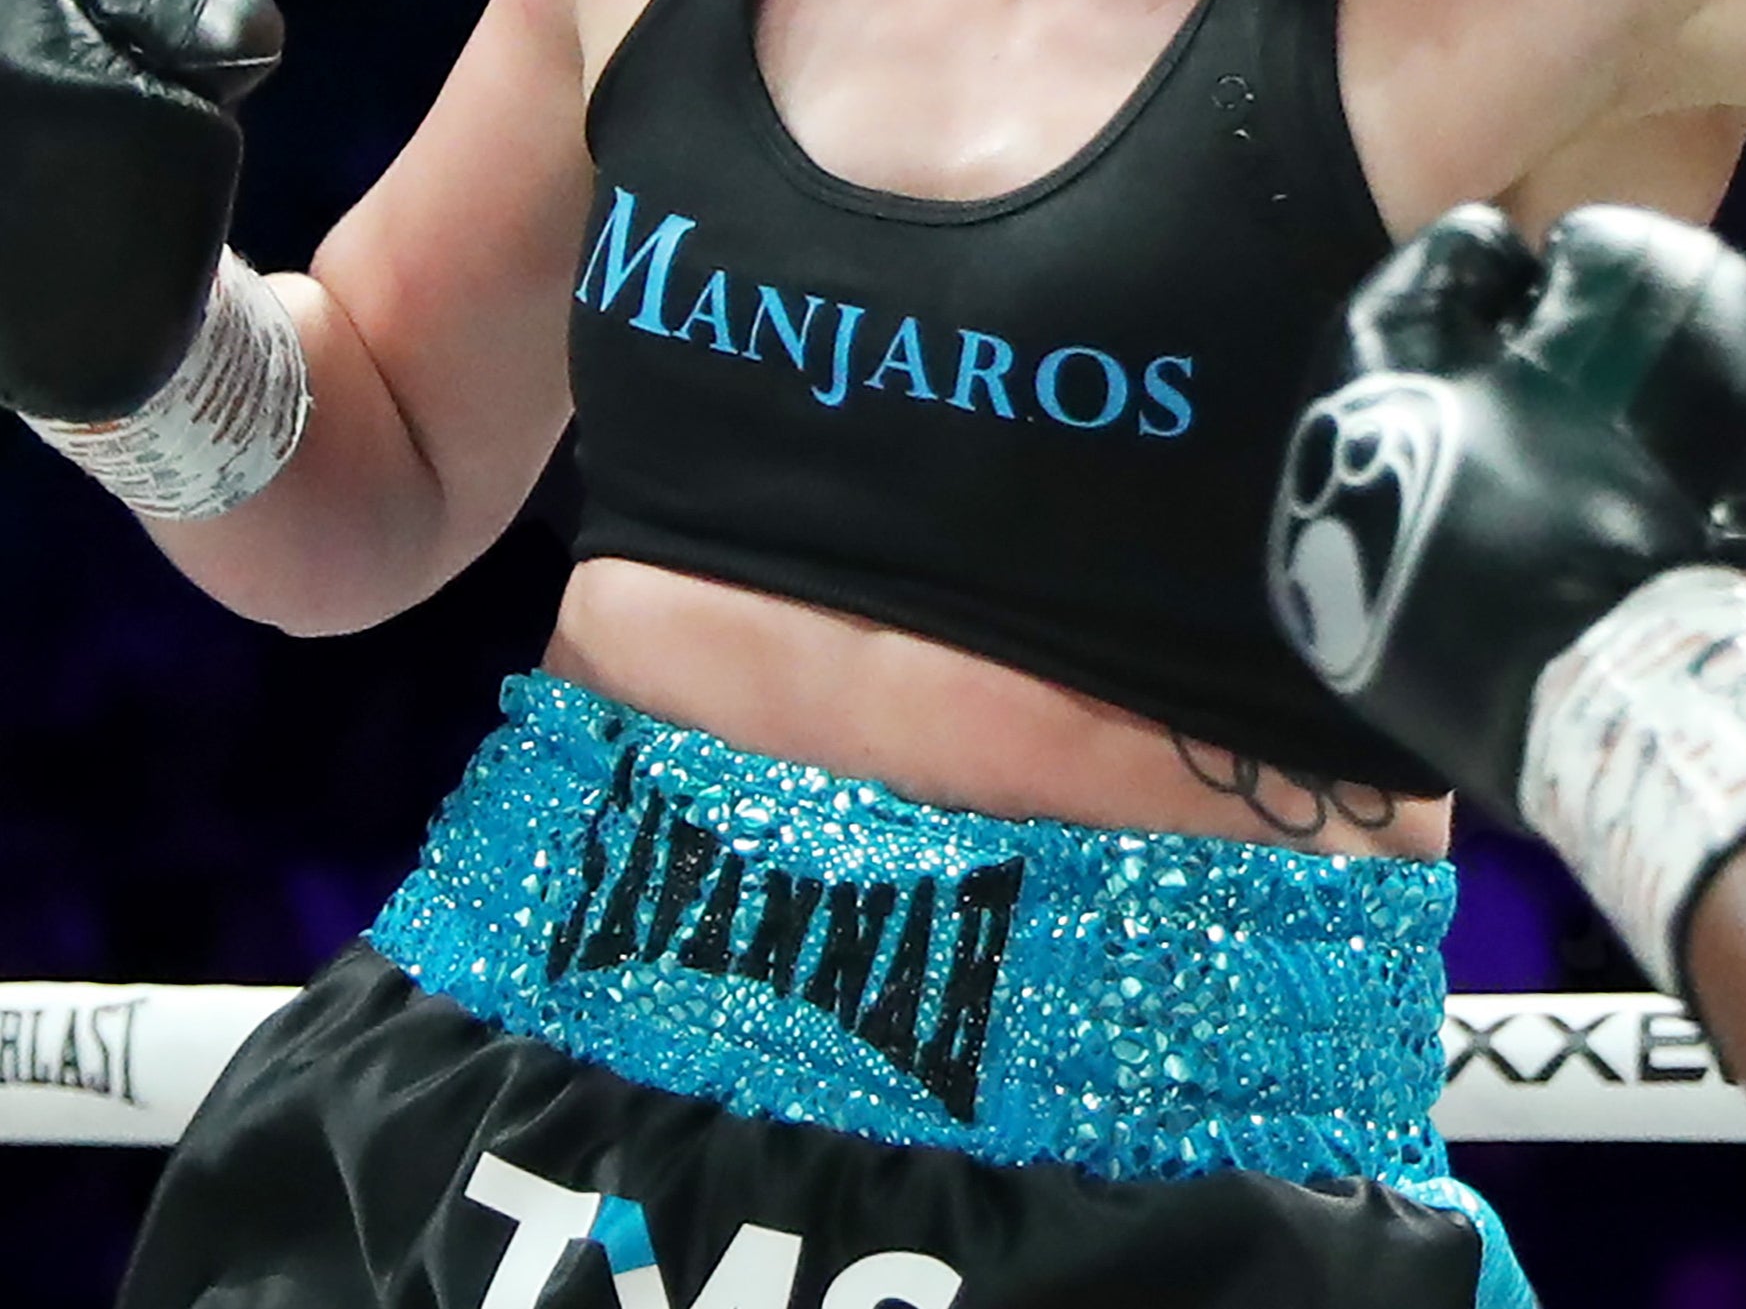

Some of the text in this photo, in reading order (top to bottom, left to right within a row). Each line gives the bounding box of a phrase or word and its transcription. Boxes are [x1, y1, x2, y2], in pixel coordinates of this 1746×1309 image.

[574, 186, 1194, 438] MANJAROS
[545, 722, 1025, 1124] SAVANNAH
[1444, 1011, 1737, 1086] XXE
